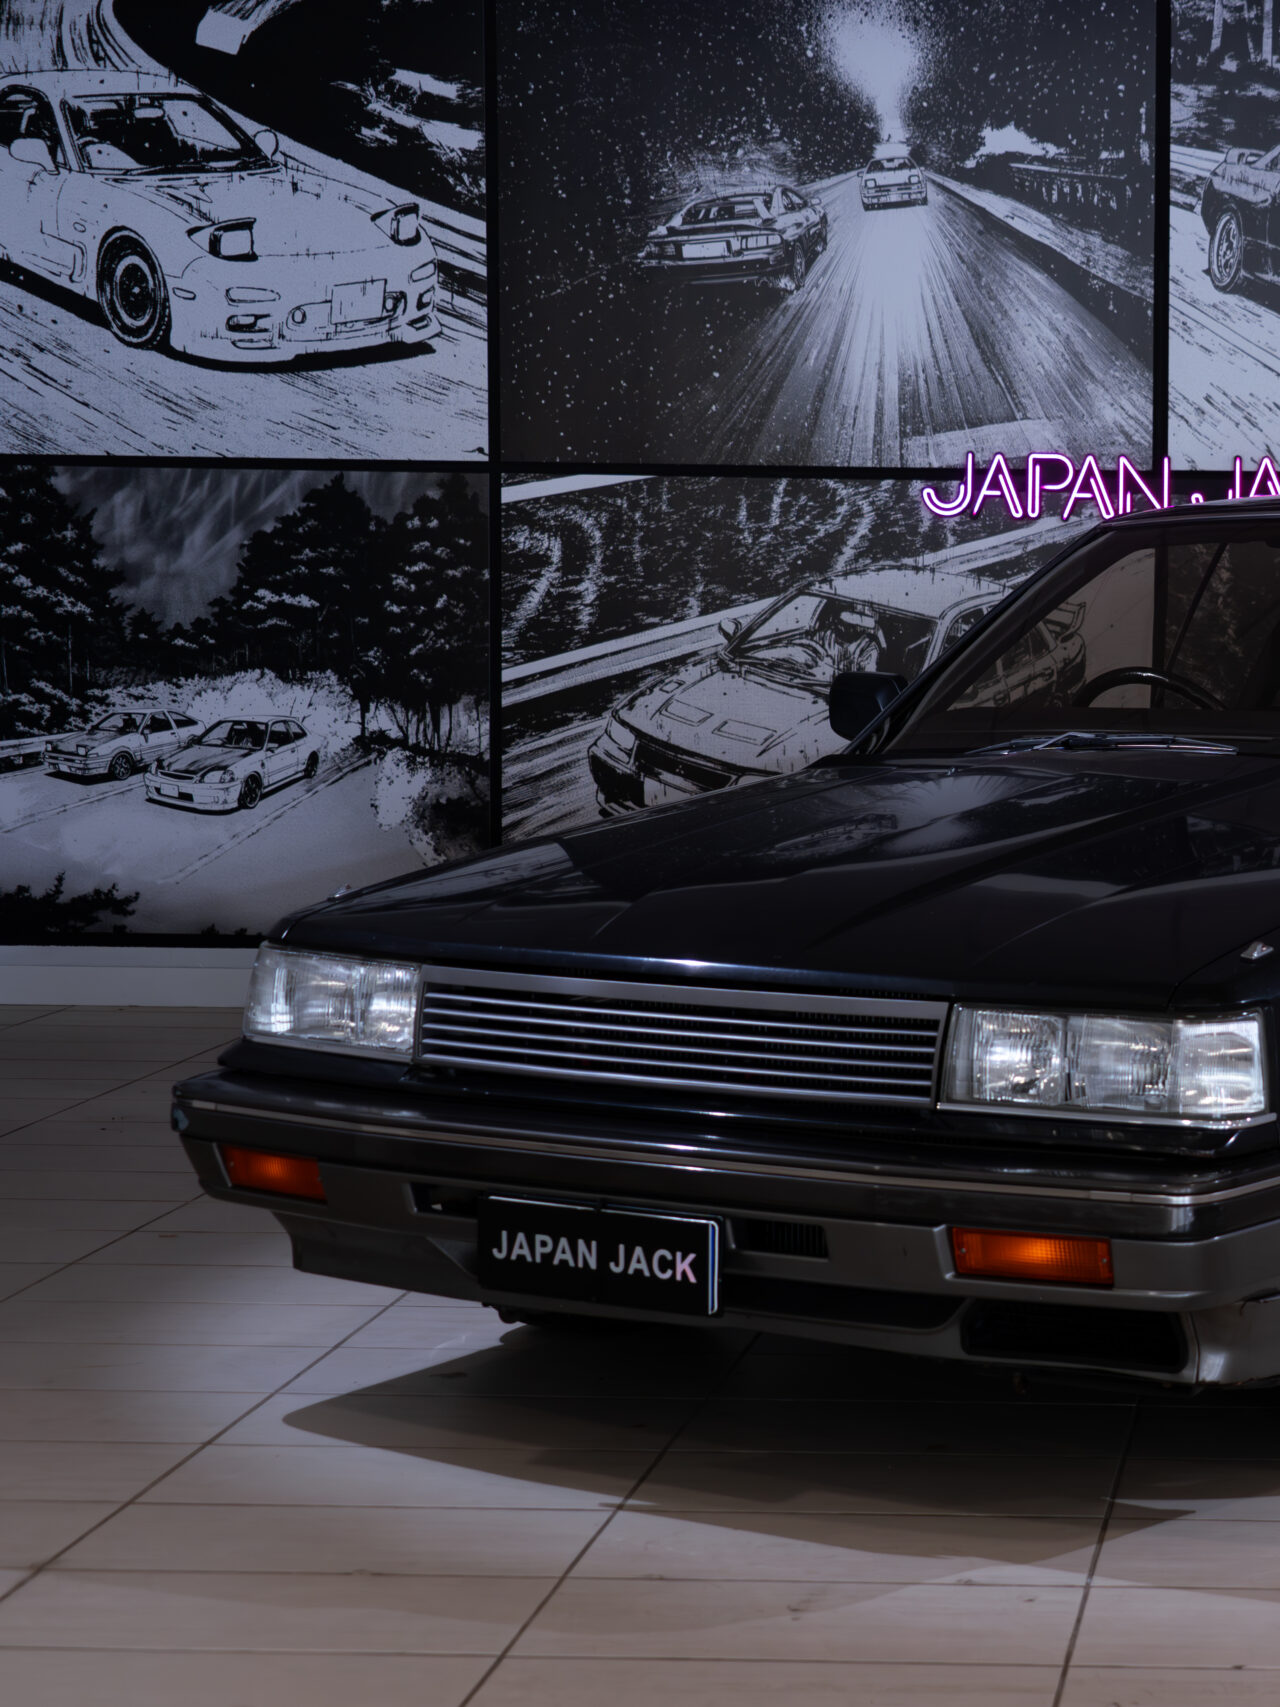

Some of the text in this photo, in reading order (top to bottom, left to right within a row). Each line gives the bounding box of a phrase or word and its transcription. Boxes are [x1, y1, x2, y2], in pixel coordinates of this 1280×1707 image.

[922, 450, 1171, 520] JAPAN
[491, 1229, 698, 1284] JAPAN JACK
